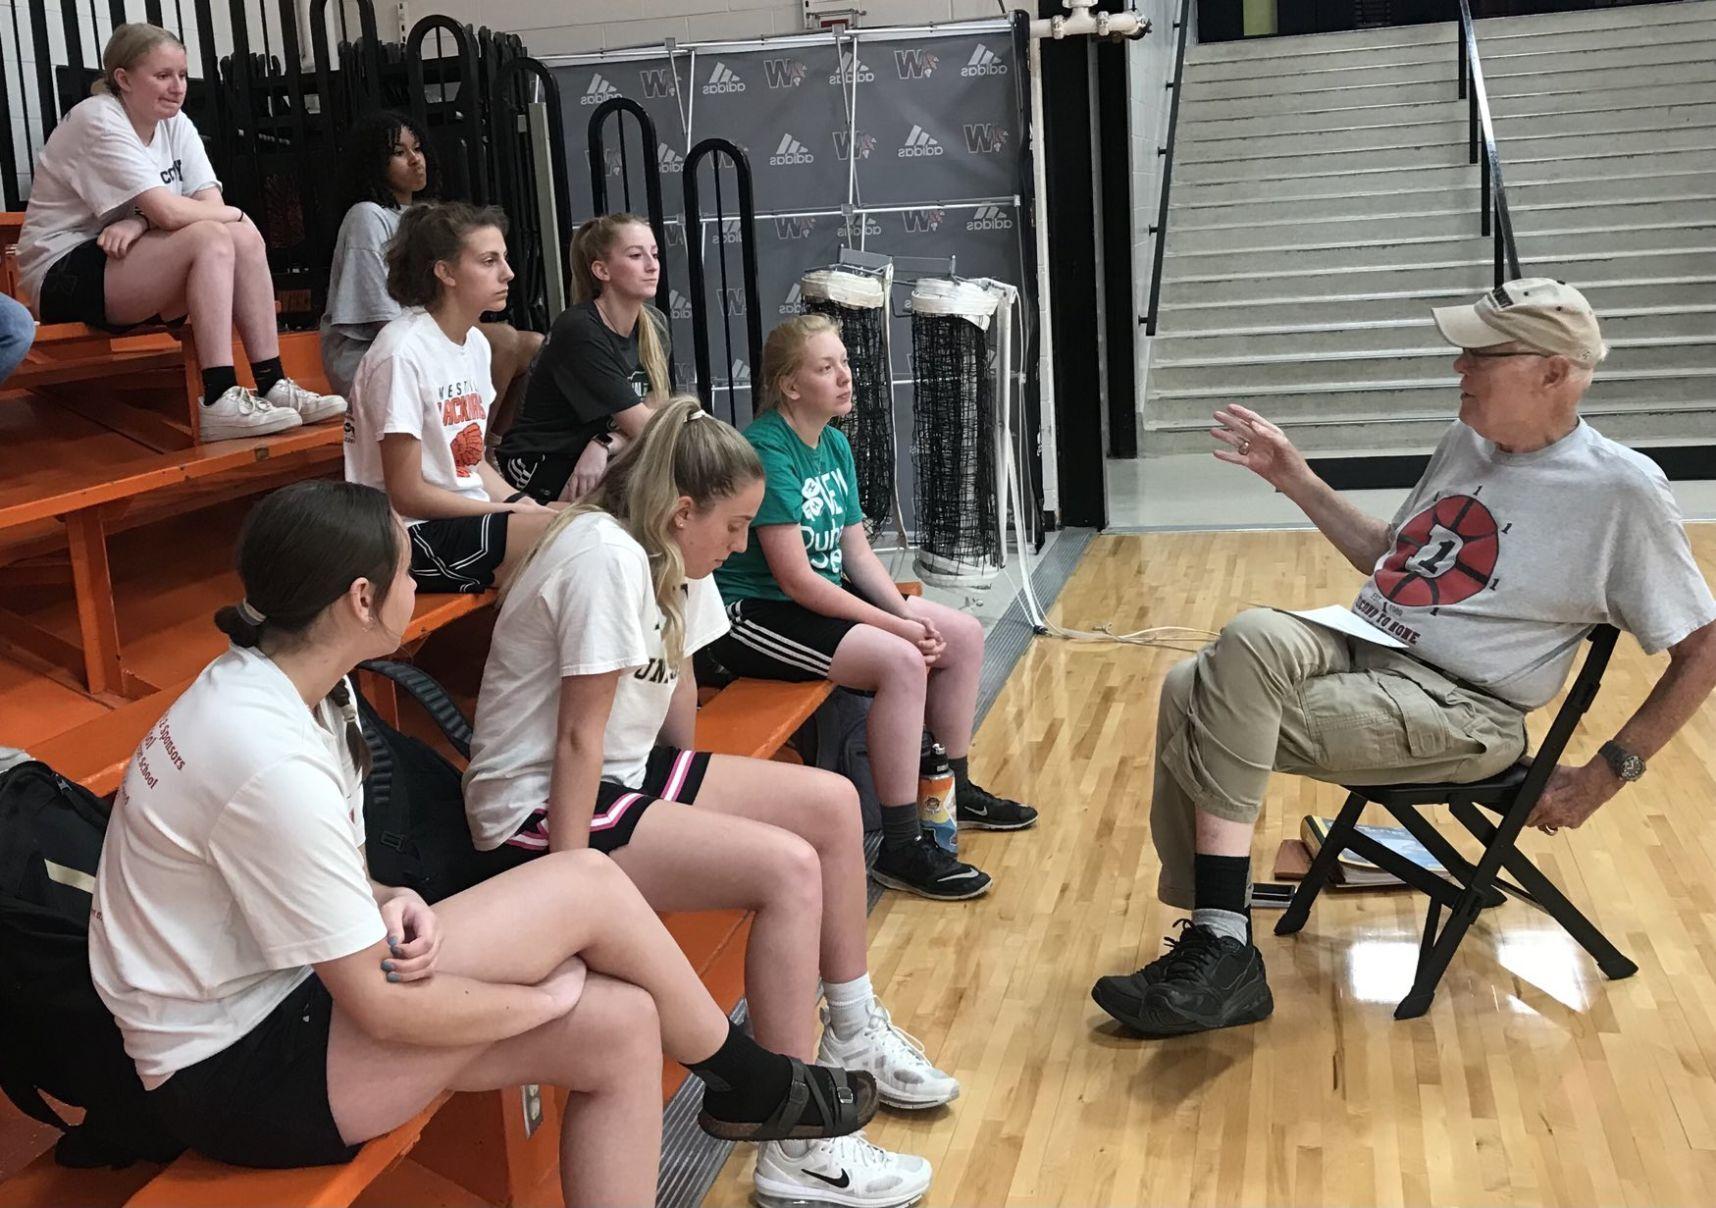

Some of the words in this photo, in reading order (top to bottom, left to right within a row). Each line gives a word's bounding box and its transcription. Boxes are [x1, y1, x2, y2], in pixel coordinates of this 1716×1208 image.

[1418, 540, 1456, 575] 1
[1376, 613, 1392, 627] TO
[159, 724, 186, 771] Sponsors
